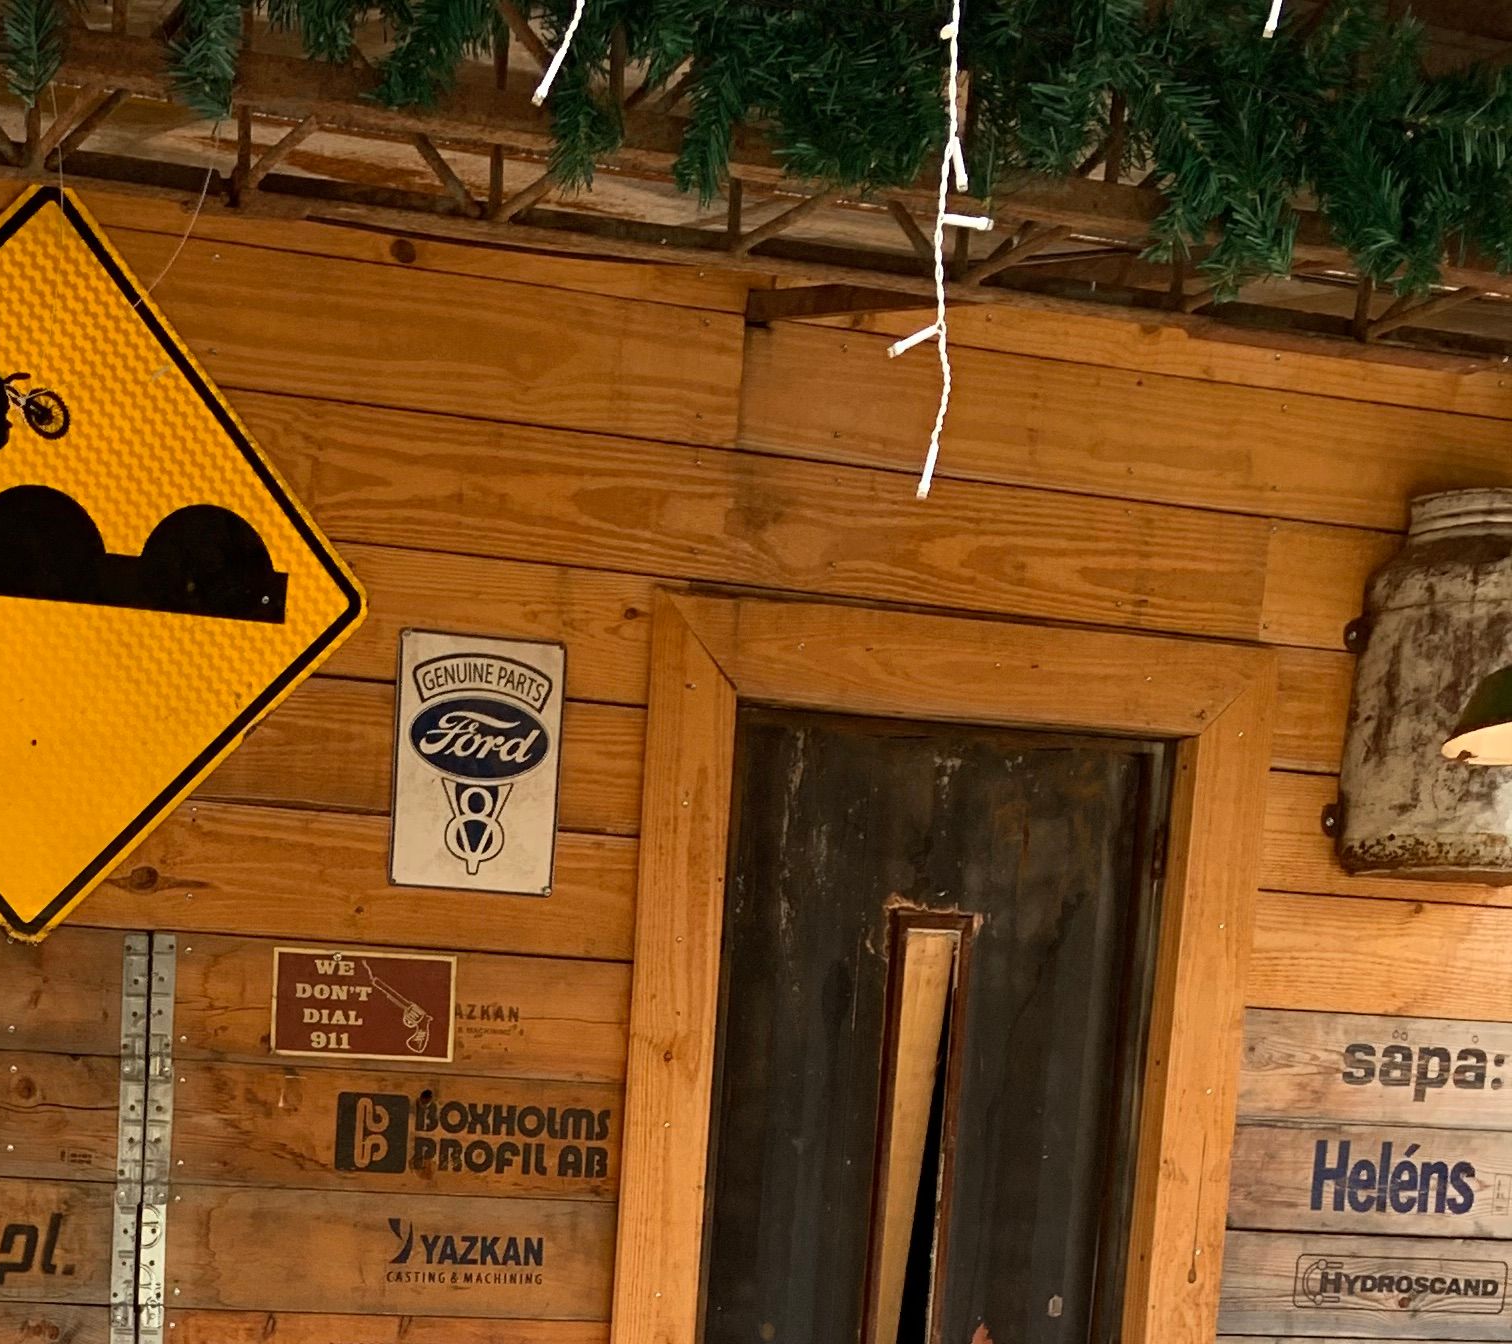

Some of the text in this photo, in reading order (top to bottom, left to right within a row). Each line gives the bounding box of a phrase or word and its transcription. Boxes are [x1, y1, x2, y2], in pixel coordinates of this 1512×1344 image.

[422, 662, 546, 702] GENUINE PARTS
[419, 711, 541, 763] Ford
[315, 960, 355, 976] WE
[295, 983, 373, 1001] DON'T
[303, 1008, 363, 1025] DIAL
[454, 1003, 519, 1022] AZKAN
[310, 1032, 351, 1049] 911
[1342, 1043, 1506, 1102] sapa:
[415, 1099, 611, 1141] BOXHOLMS
[412, 1138, 609, 1178] PROFIL AB
[1310, 1139, 1476, 1215] Heléns
[420, 1234, 544, 1266] YAZKAN
[386, 1271, 543, 1285] CASTING & MACHINING
[1319, 1271, 1499, 1297] HYDROSCAND
